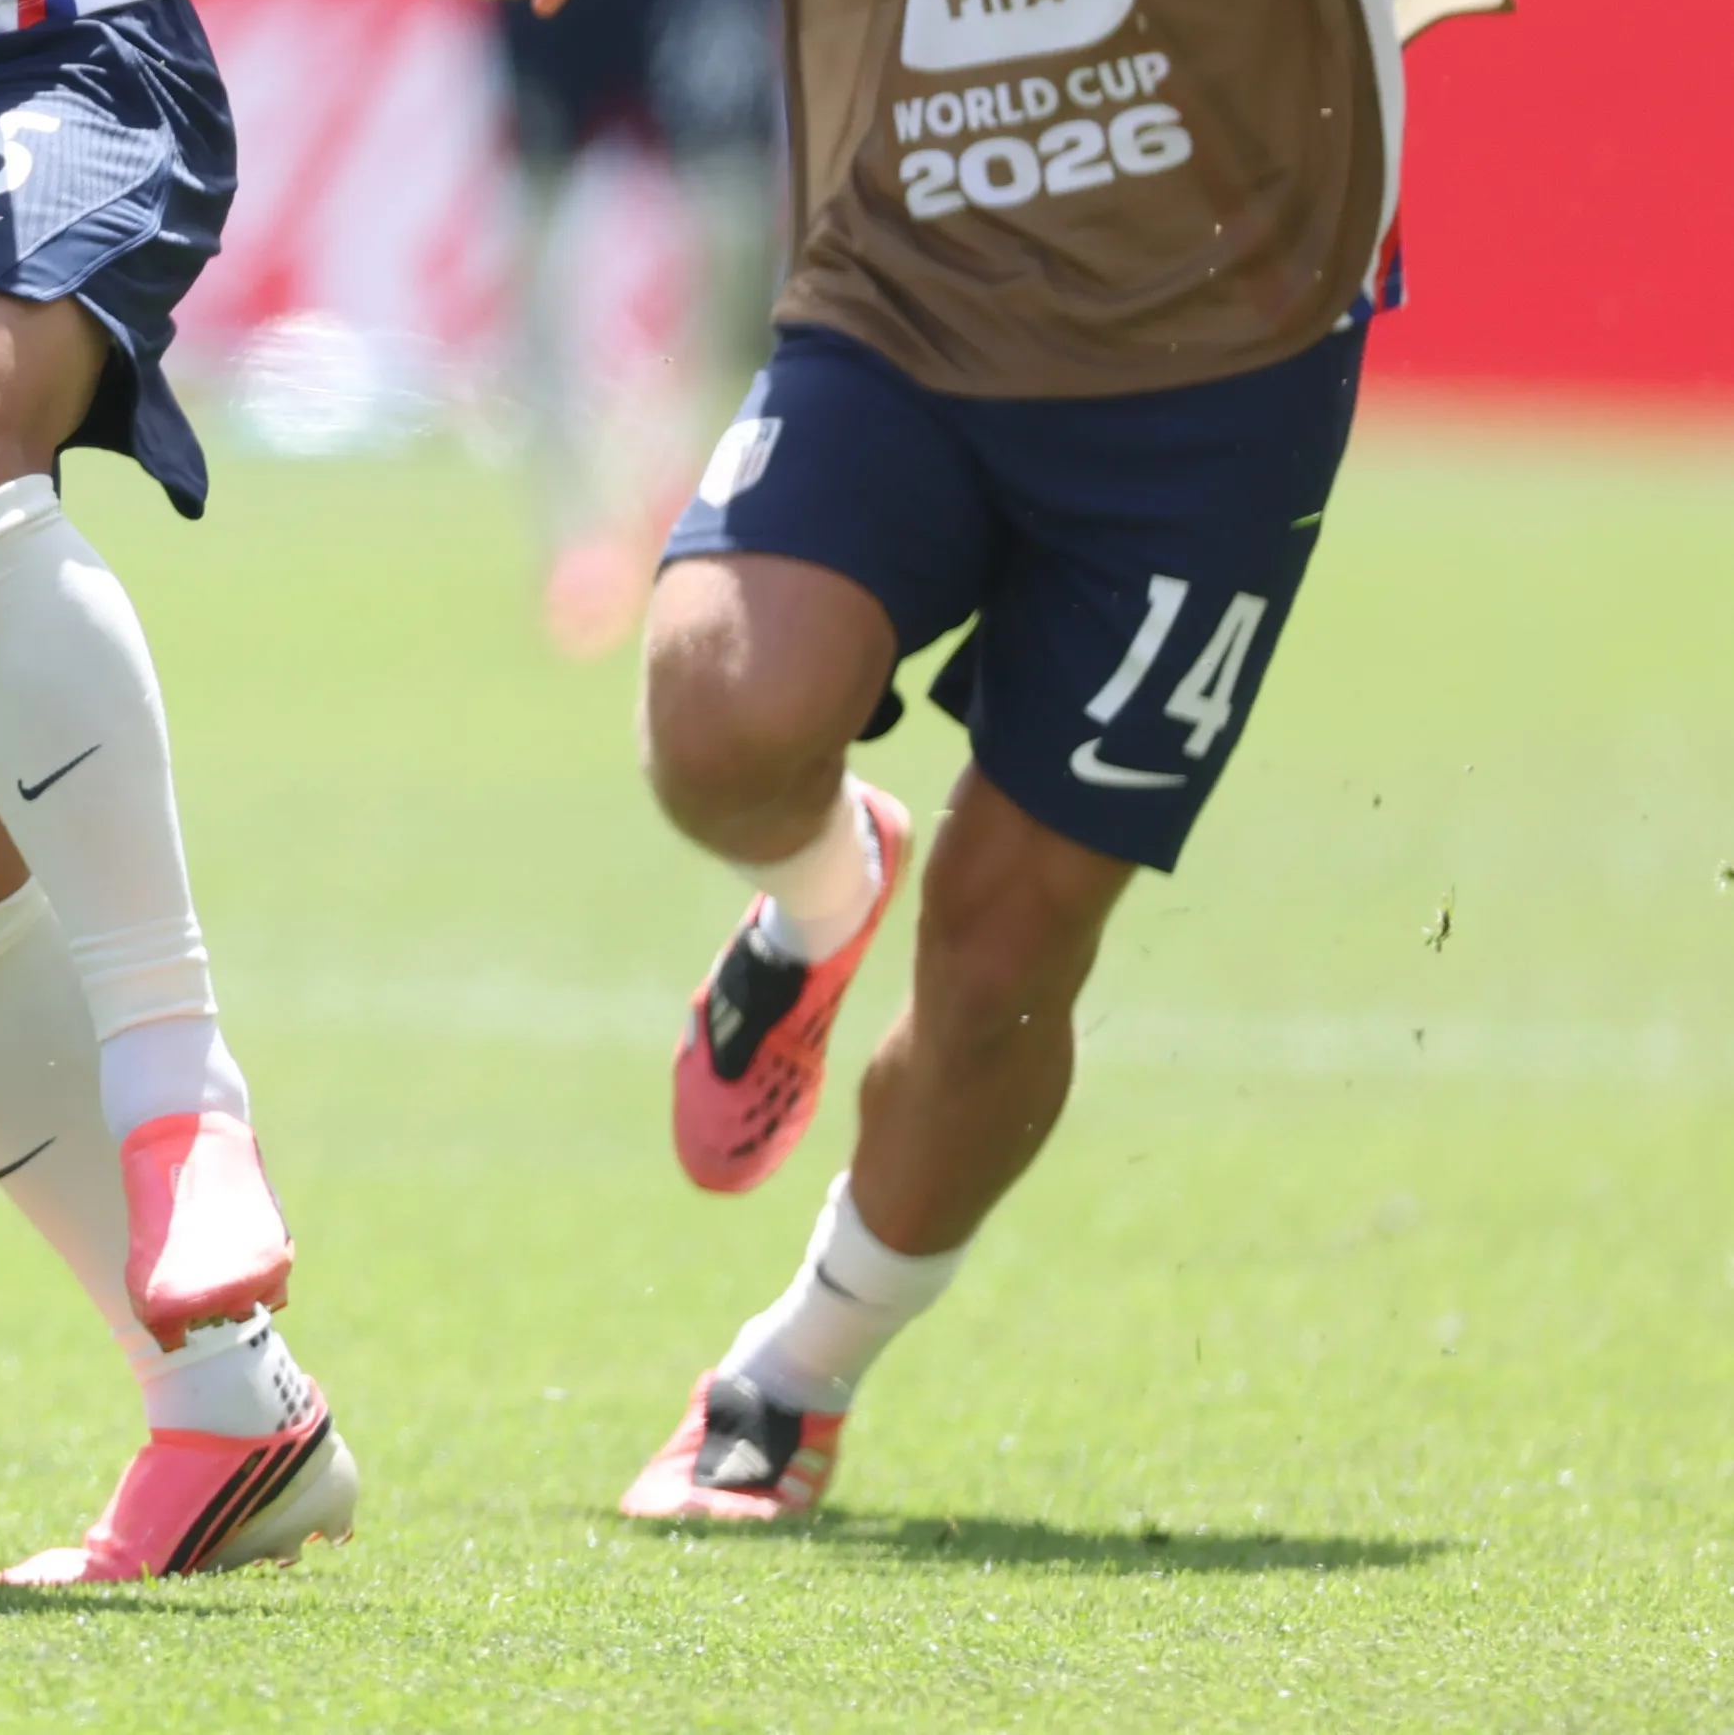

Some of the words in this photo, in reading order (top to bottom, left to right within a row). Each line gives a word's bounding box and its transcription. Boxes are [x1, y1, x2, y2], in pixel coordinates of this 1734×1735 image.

[892, 76, 1059, 145] WORLD
[1066, 51, 1170, 108] CUP
[898, 102, 1194, 222] 2026
[1083, 572, 1269, 760] 14
